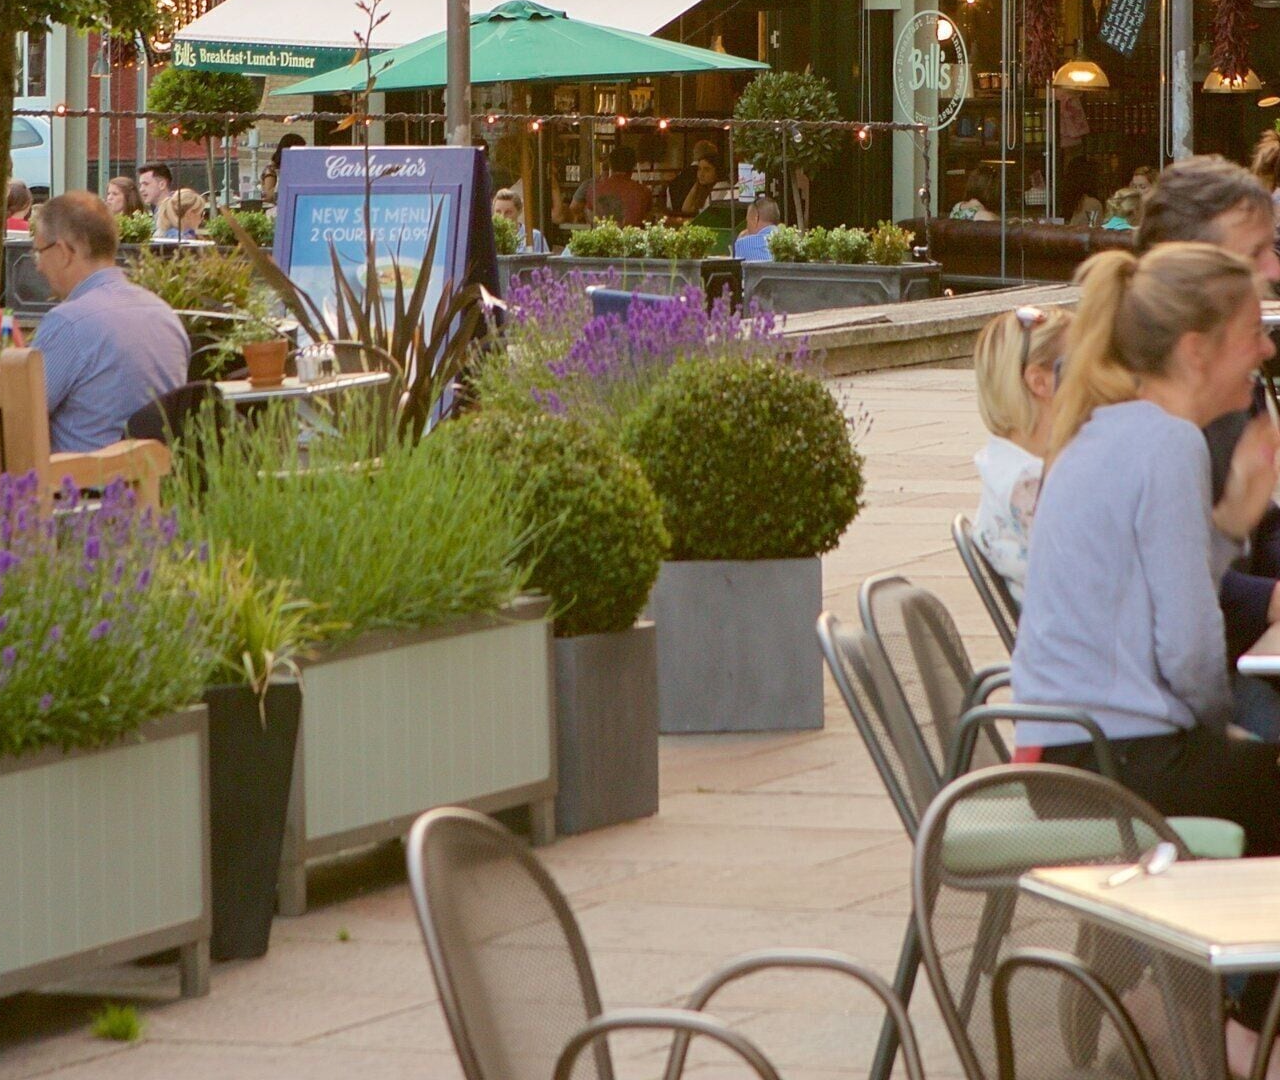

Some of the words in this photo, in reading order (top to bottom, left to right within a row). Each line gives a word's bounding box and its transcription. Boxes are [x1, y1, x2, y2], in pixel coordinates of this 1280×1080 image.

[174, 41, 197, 68] Bill's
[908, 43, 952, 91] Bill's
[324, 154, 427, 180] Carluio's
[311, 207, 349, 225] NEW
[353, 207, 381, 225] ST
[384, 207, 428, 224] MENU
[310, 227, 320, 243] 2
[322, 227, 385, 243] COURS
